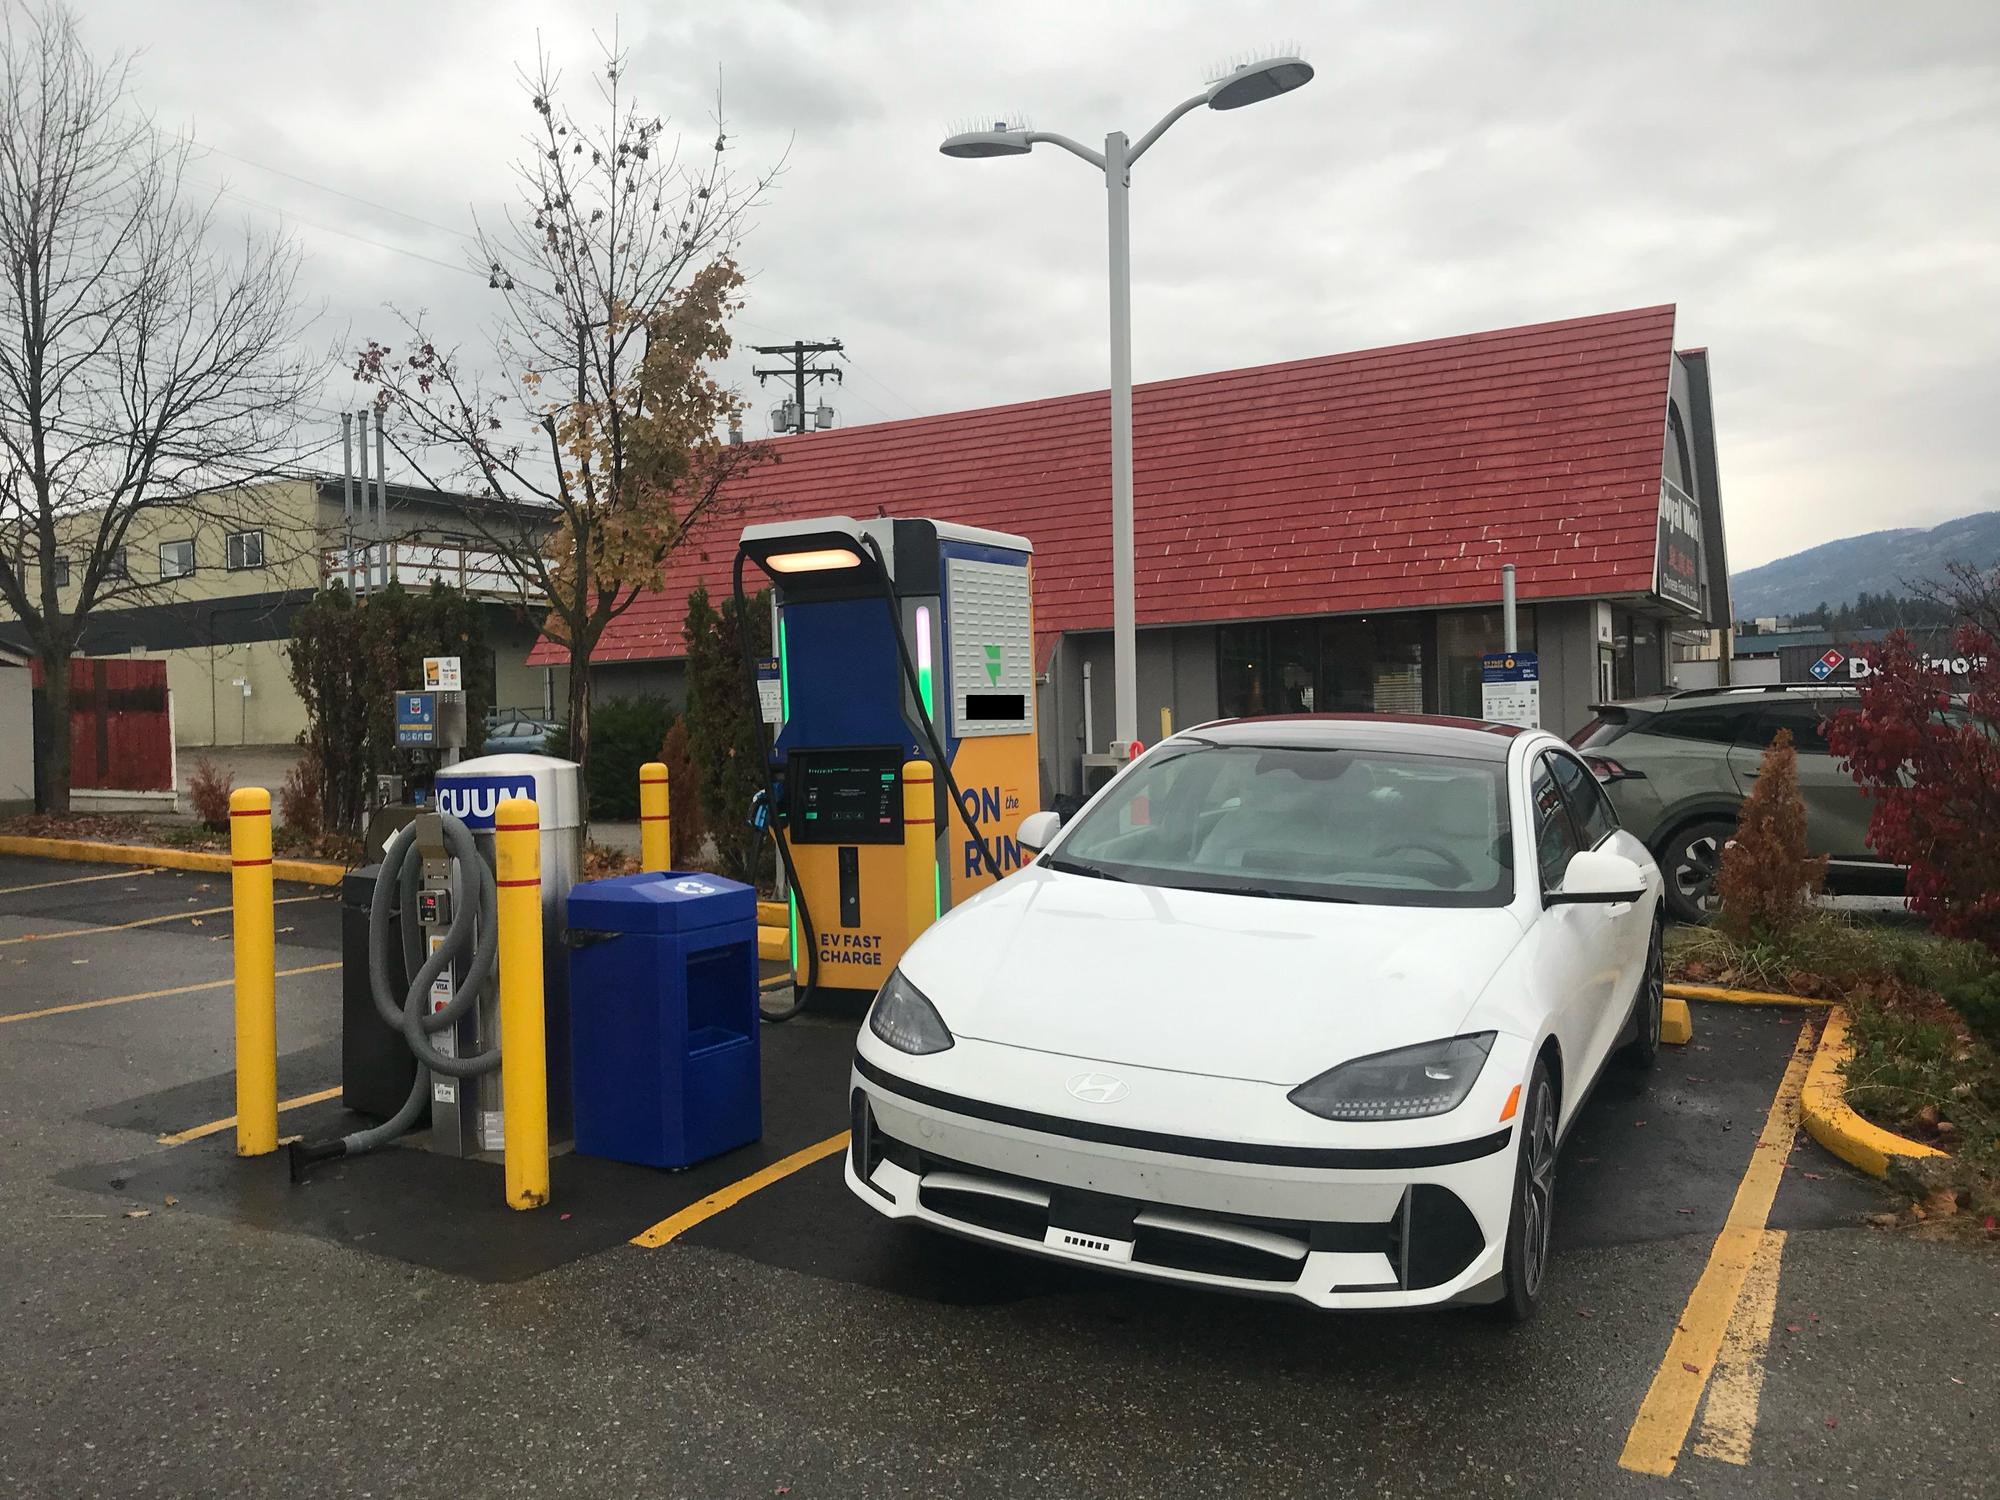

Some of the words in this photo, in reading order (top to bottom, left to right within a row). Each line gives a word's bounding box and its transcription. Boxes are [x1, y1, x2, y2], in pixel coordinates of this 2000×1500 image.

[774, 747, 779, 758] 1
[912, 744, 920, 755] 2
[961, 786, 1000, 824] ON
[1004, 795, 1019, 809] the
[964, 835, 1021, 878] RUN
[820, 933, 840, 946] EV
[843, 934, 881, 949] FAST
[820, 950, 882, 966] CHARGE
[435, 982, 449, 991] VISA
